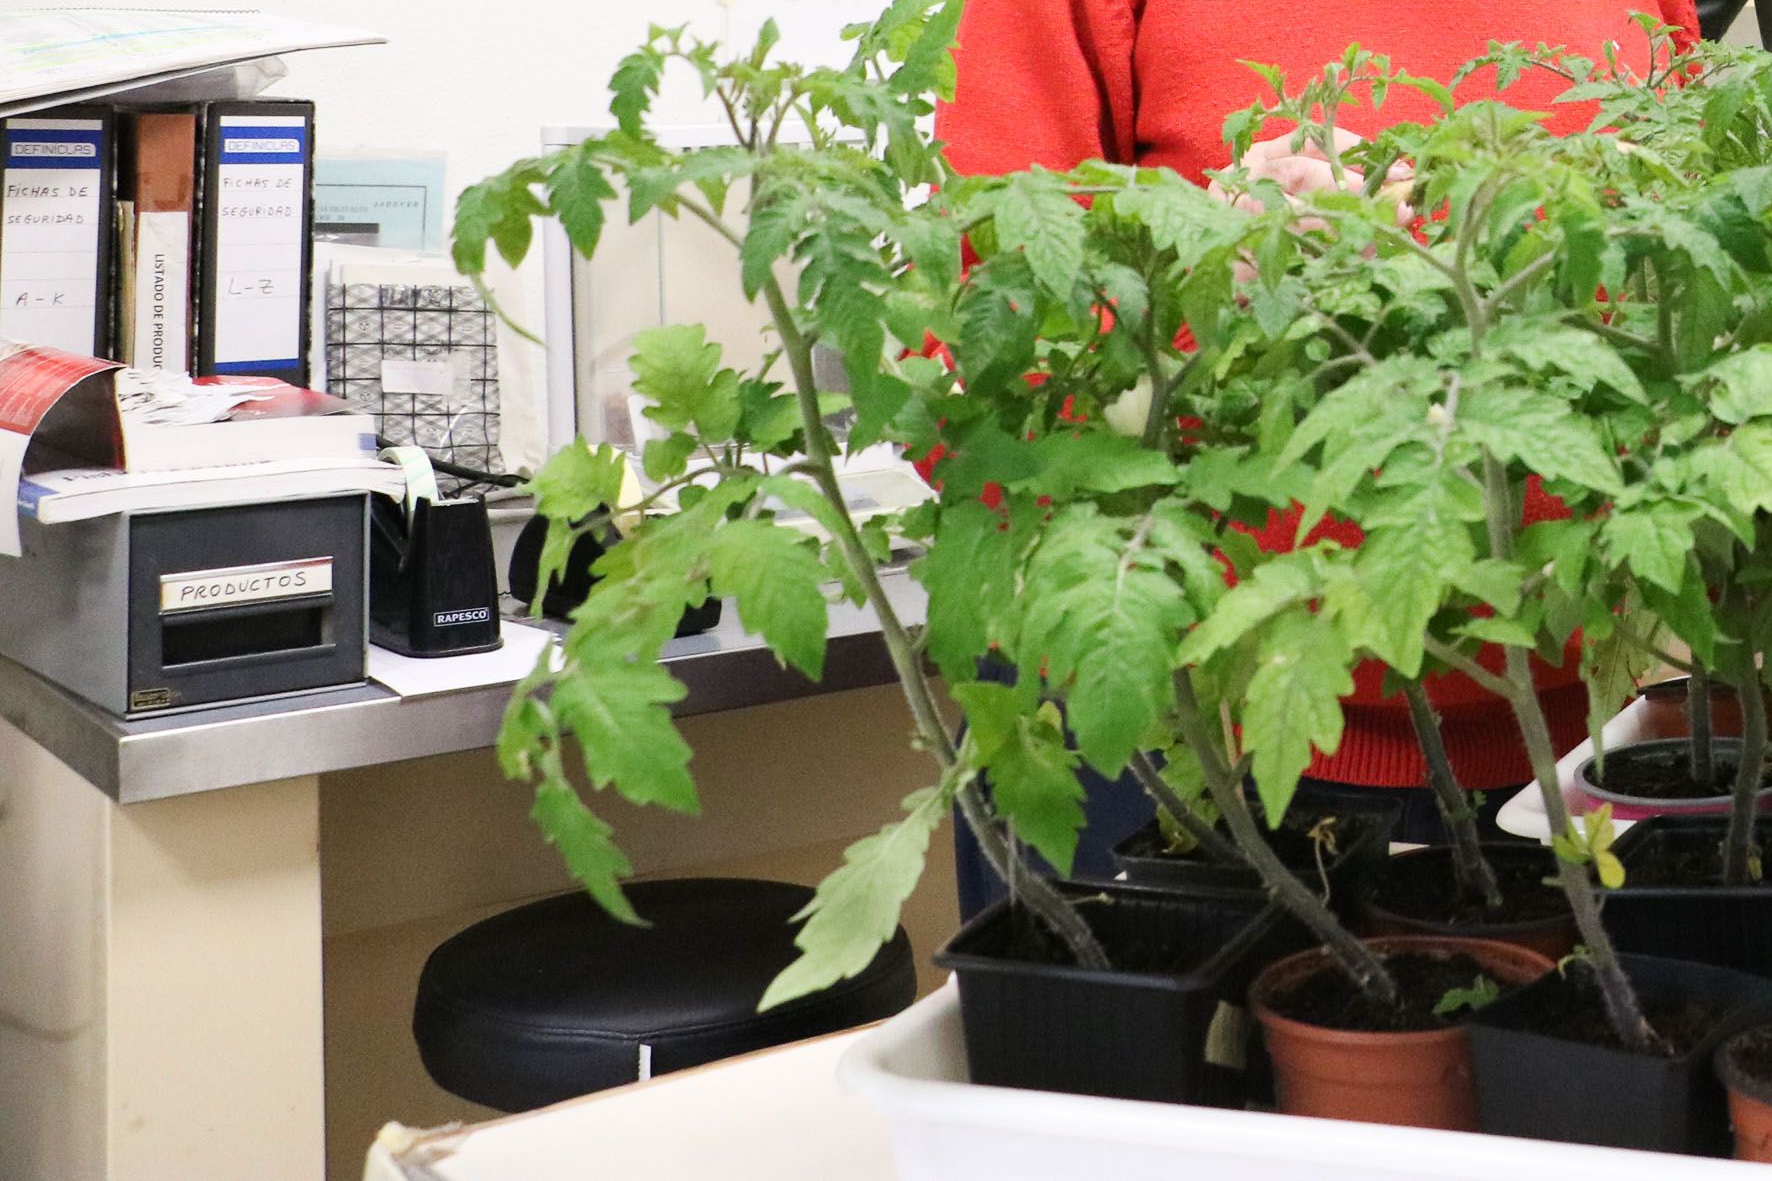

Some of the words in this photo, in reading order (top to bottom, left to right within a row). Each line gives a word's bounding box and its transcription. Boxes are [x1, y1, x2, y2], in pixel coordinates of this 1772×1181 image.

[14, 144, 92, 156] DEFINICLAS
[228, 141, 296, 151] DEFINICLAS
[276, 178, 293, 188] DE
[69, 186, 89, 197] DE
[222, 206, 293, 217] SEGURIDAD
[7, 213, 85, 225] SEGURIDAD
[154, 254, 165, 302] LISTADO
[16, 292, 28, 307] A
[53, 292, 65, 307] K
[153, 304, 164, 319] DE
[181, 571, 307, 602] PRODUCTOS
[436, 609, 488, 624] RAPESCO
